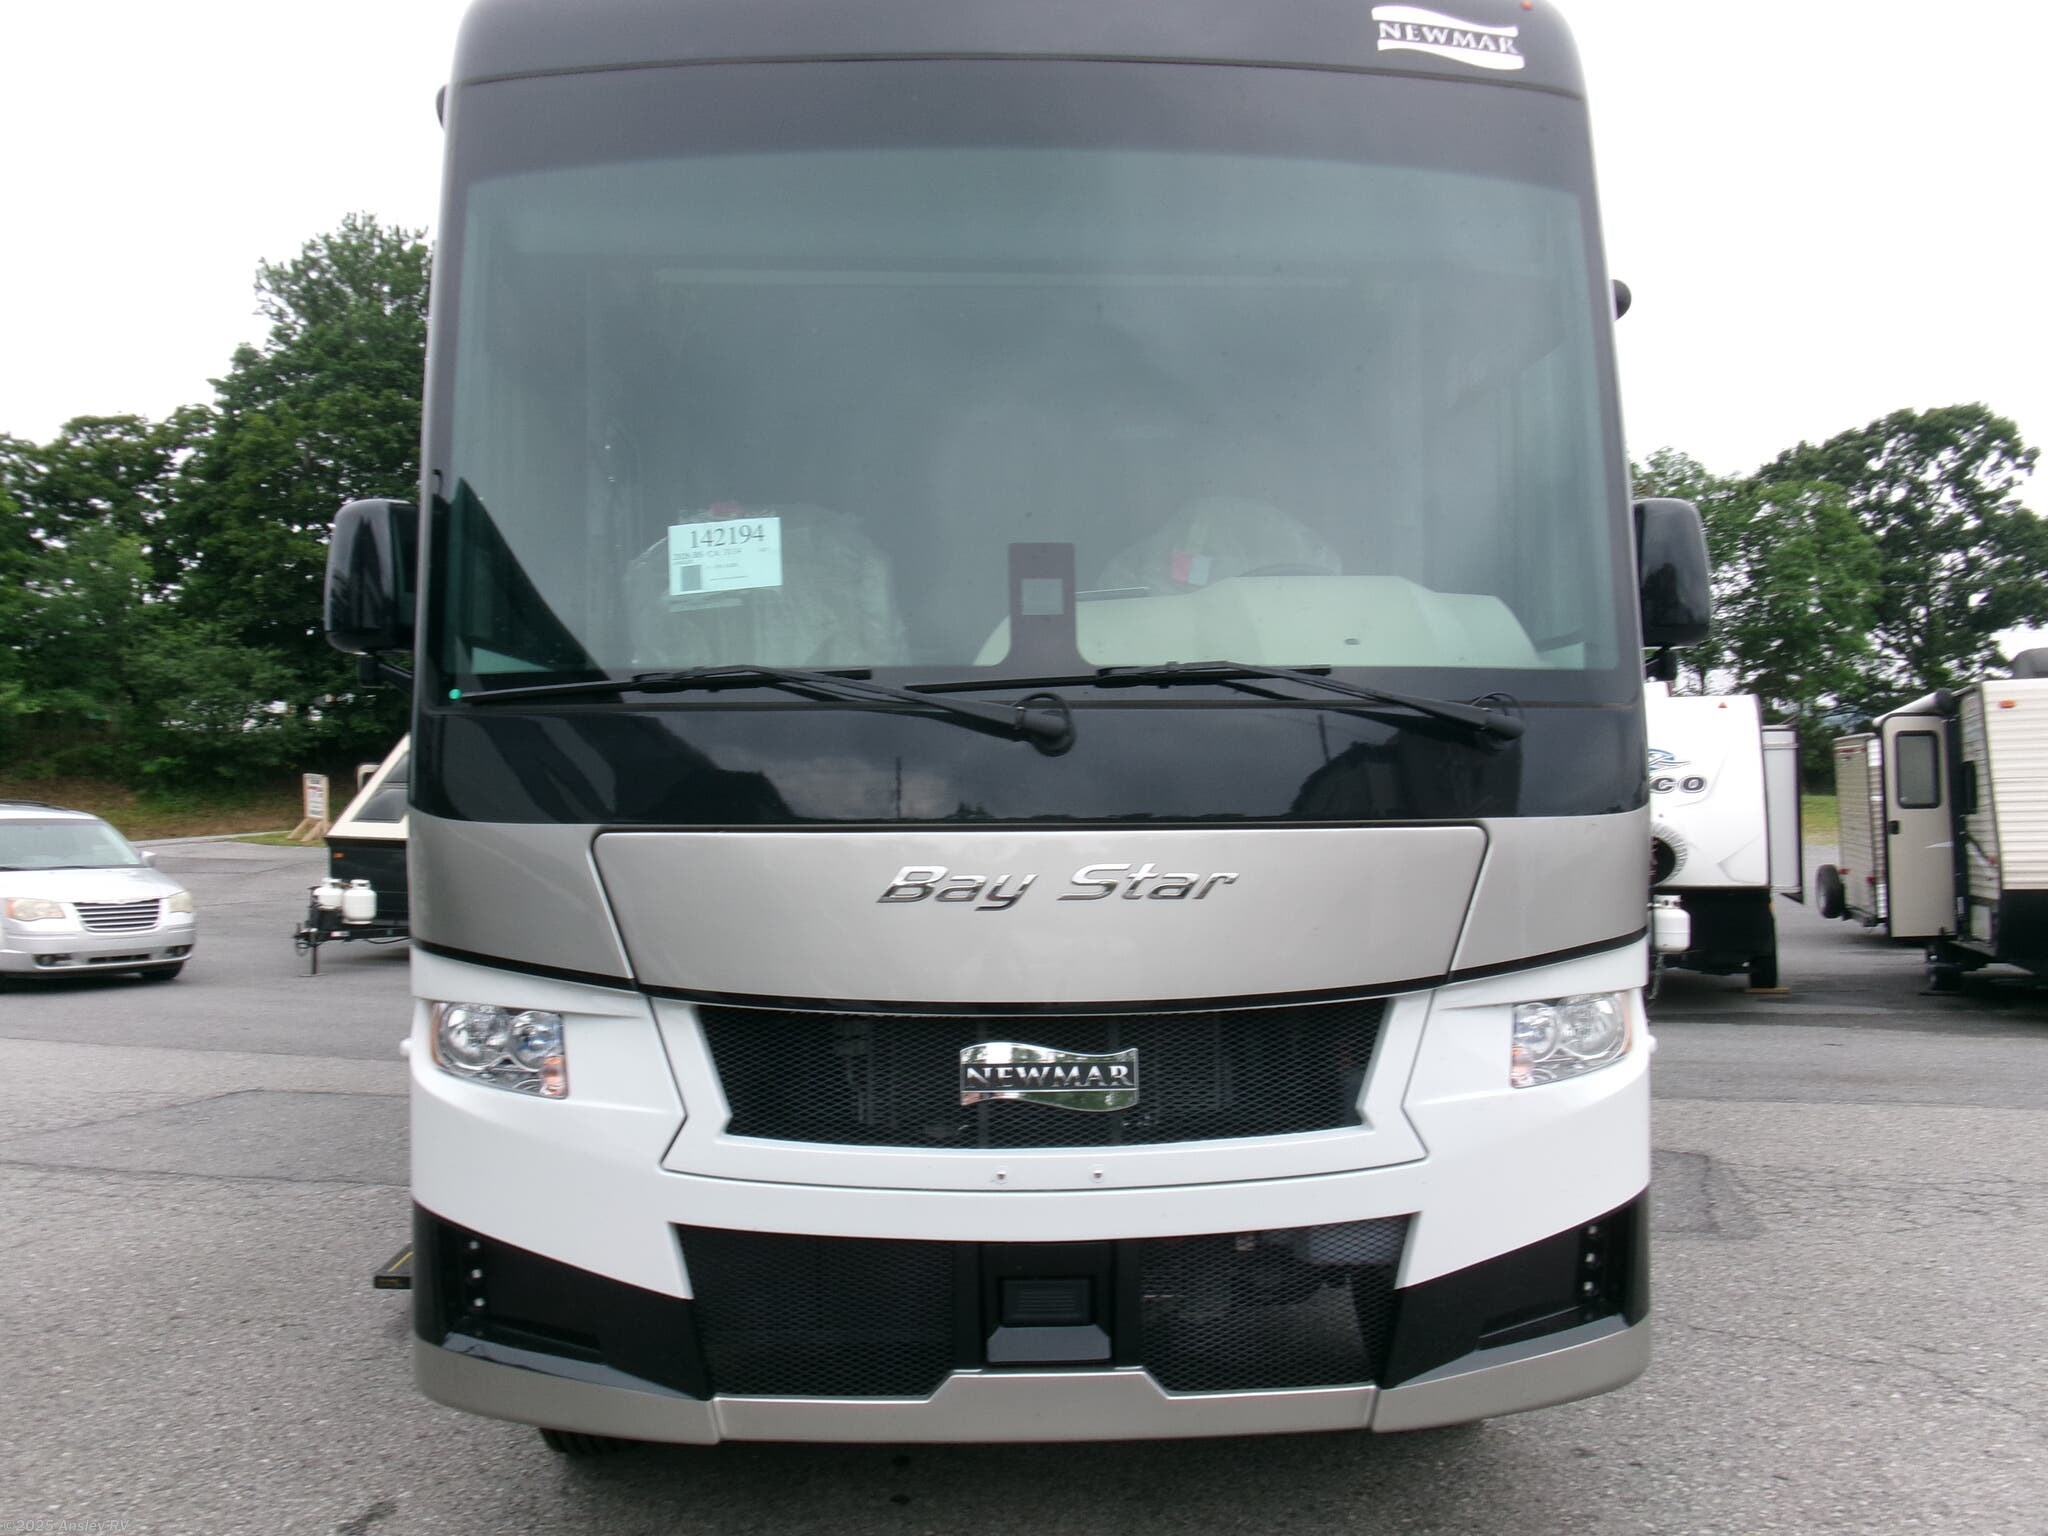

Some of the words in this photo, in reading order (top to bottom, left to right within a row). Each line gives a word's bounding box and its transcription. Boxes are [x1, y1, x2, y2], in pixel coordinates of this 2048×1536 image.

[1378, 22, 1519, 54] NEWMAR
[689, 524, 766, 549] 142194
[876, 865, 1039, 911] Bay
[1056, 862, 1239, 900] Star
[965, 1065, 1135, 1088] NEWMAR
